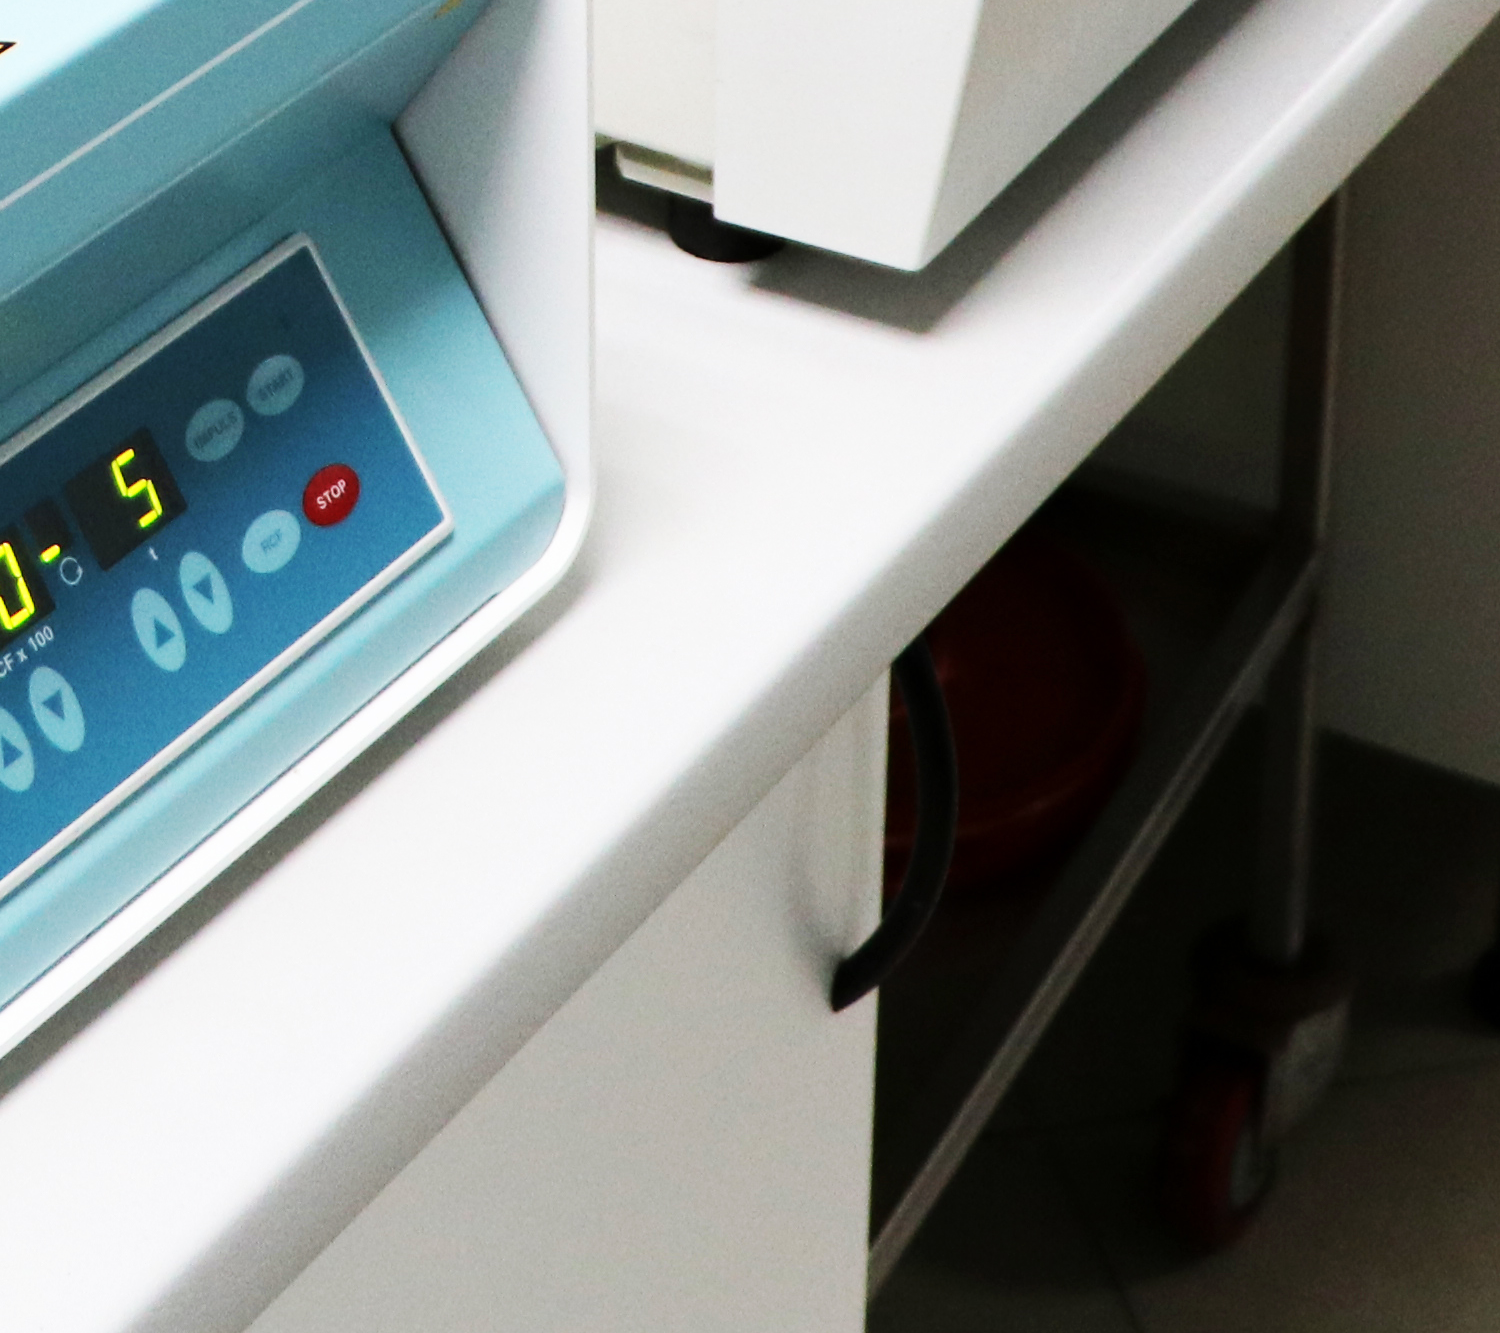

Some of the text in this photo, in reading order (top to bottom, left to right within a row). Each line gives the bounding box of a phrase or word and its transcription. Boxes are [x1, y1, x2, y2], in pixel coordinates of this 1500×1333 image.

[109, 447, 165, 531] 5
[316, 478, 347, 510] STOP
[17, 647, 28, 663] x
[28, 625, 55, 652] 100
